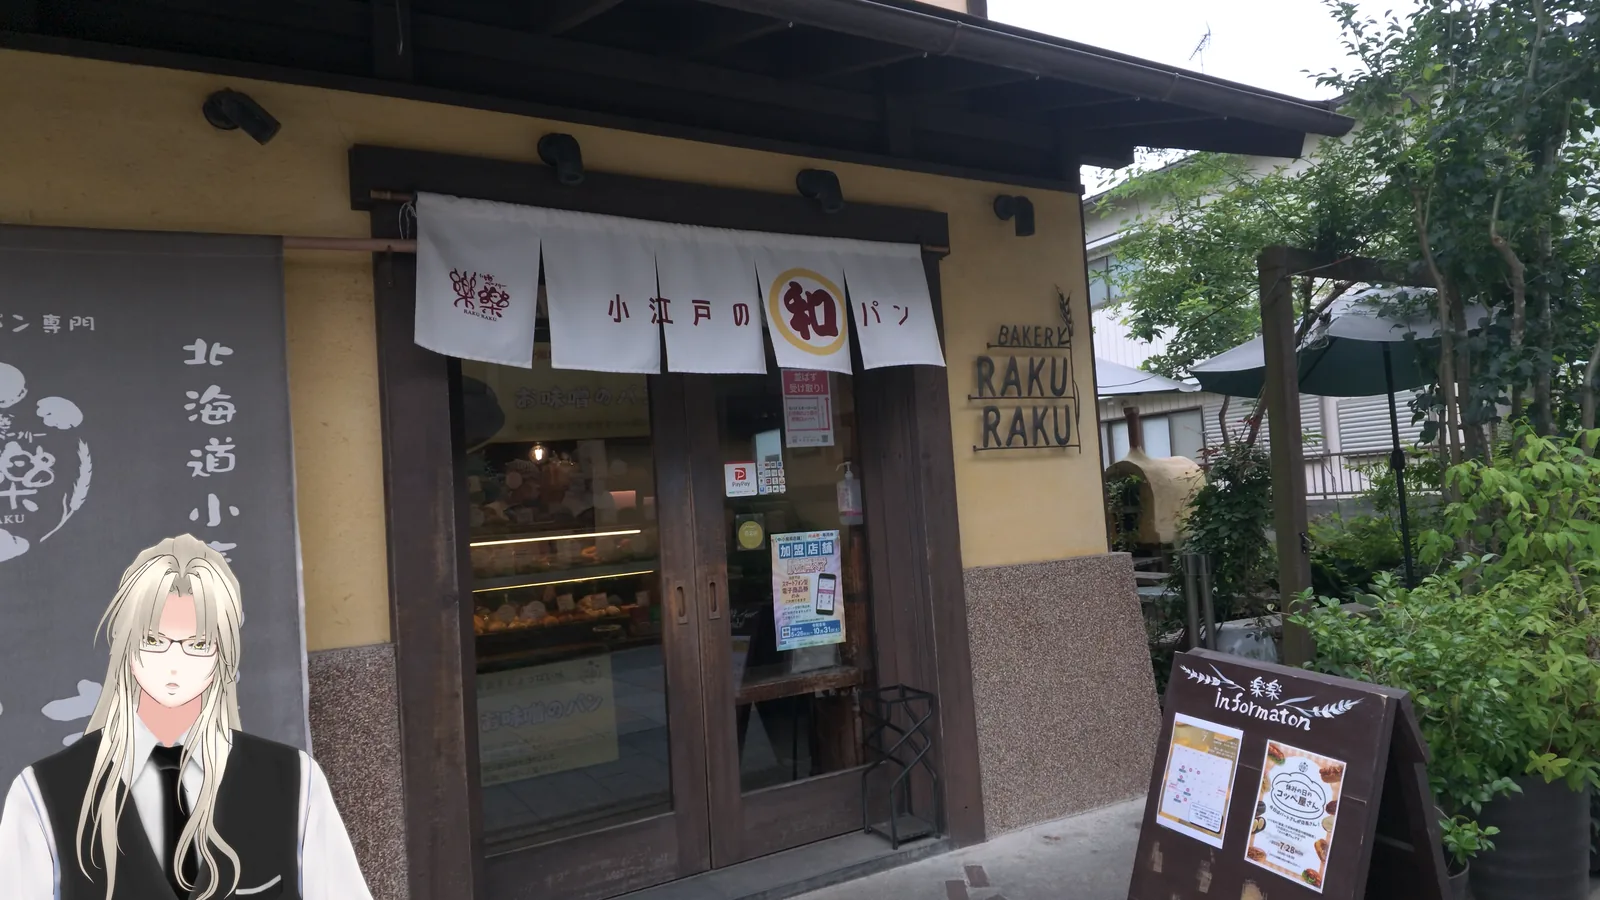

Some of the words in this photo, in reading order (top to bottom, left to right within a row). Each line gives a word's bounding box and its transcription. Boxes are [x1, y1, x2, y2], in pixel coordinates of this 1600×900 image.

[0, 313, 95, 333] ン専門
[997, 325, 1071, 346] BAKERY
[976, 355, 1068, 397] RAKU
[983, 405, 1071, 447] RAKU
[183, 338, 240, 562] 北海道小
[780, 542, 833, 557] 加盟店舗
[1250, 676, 1282, 701] 楽楽
[1214, 687, 1311, 731] informaton
[1276, 789, 1319, 810] コッペ屋さん
[1285, 783, 1313, 798] 休みの日の
